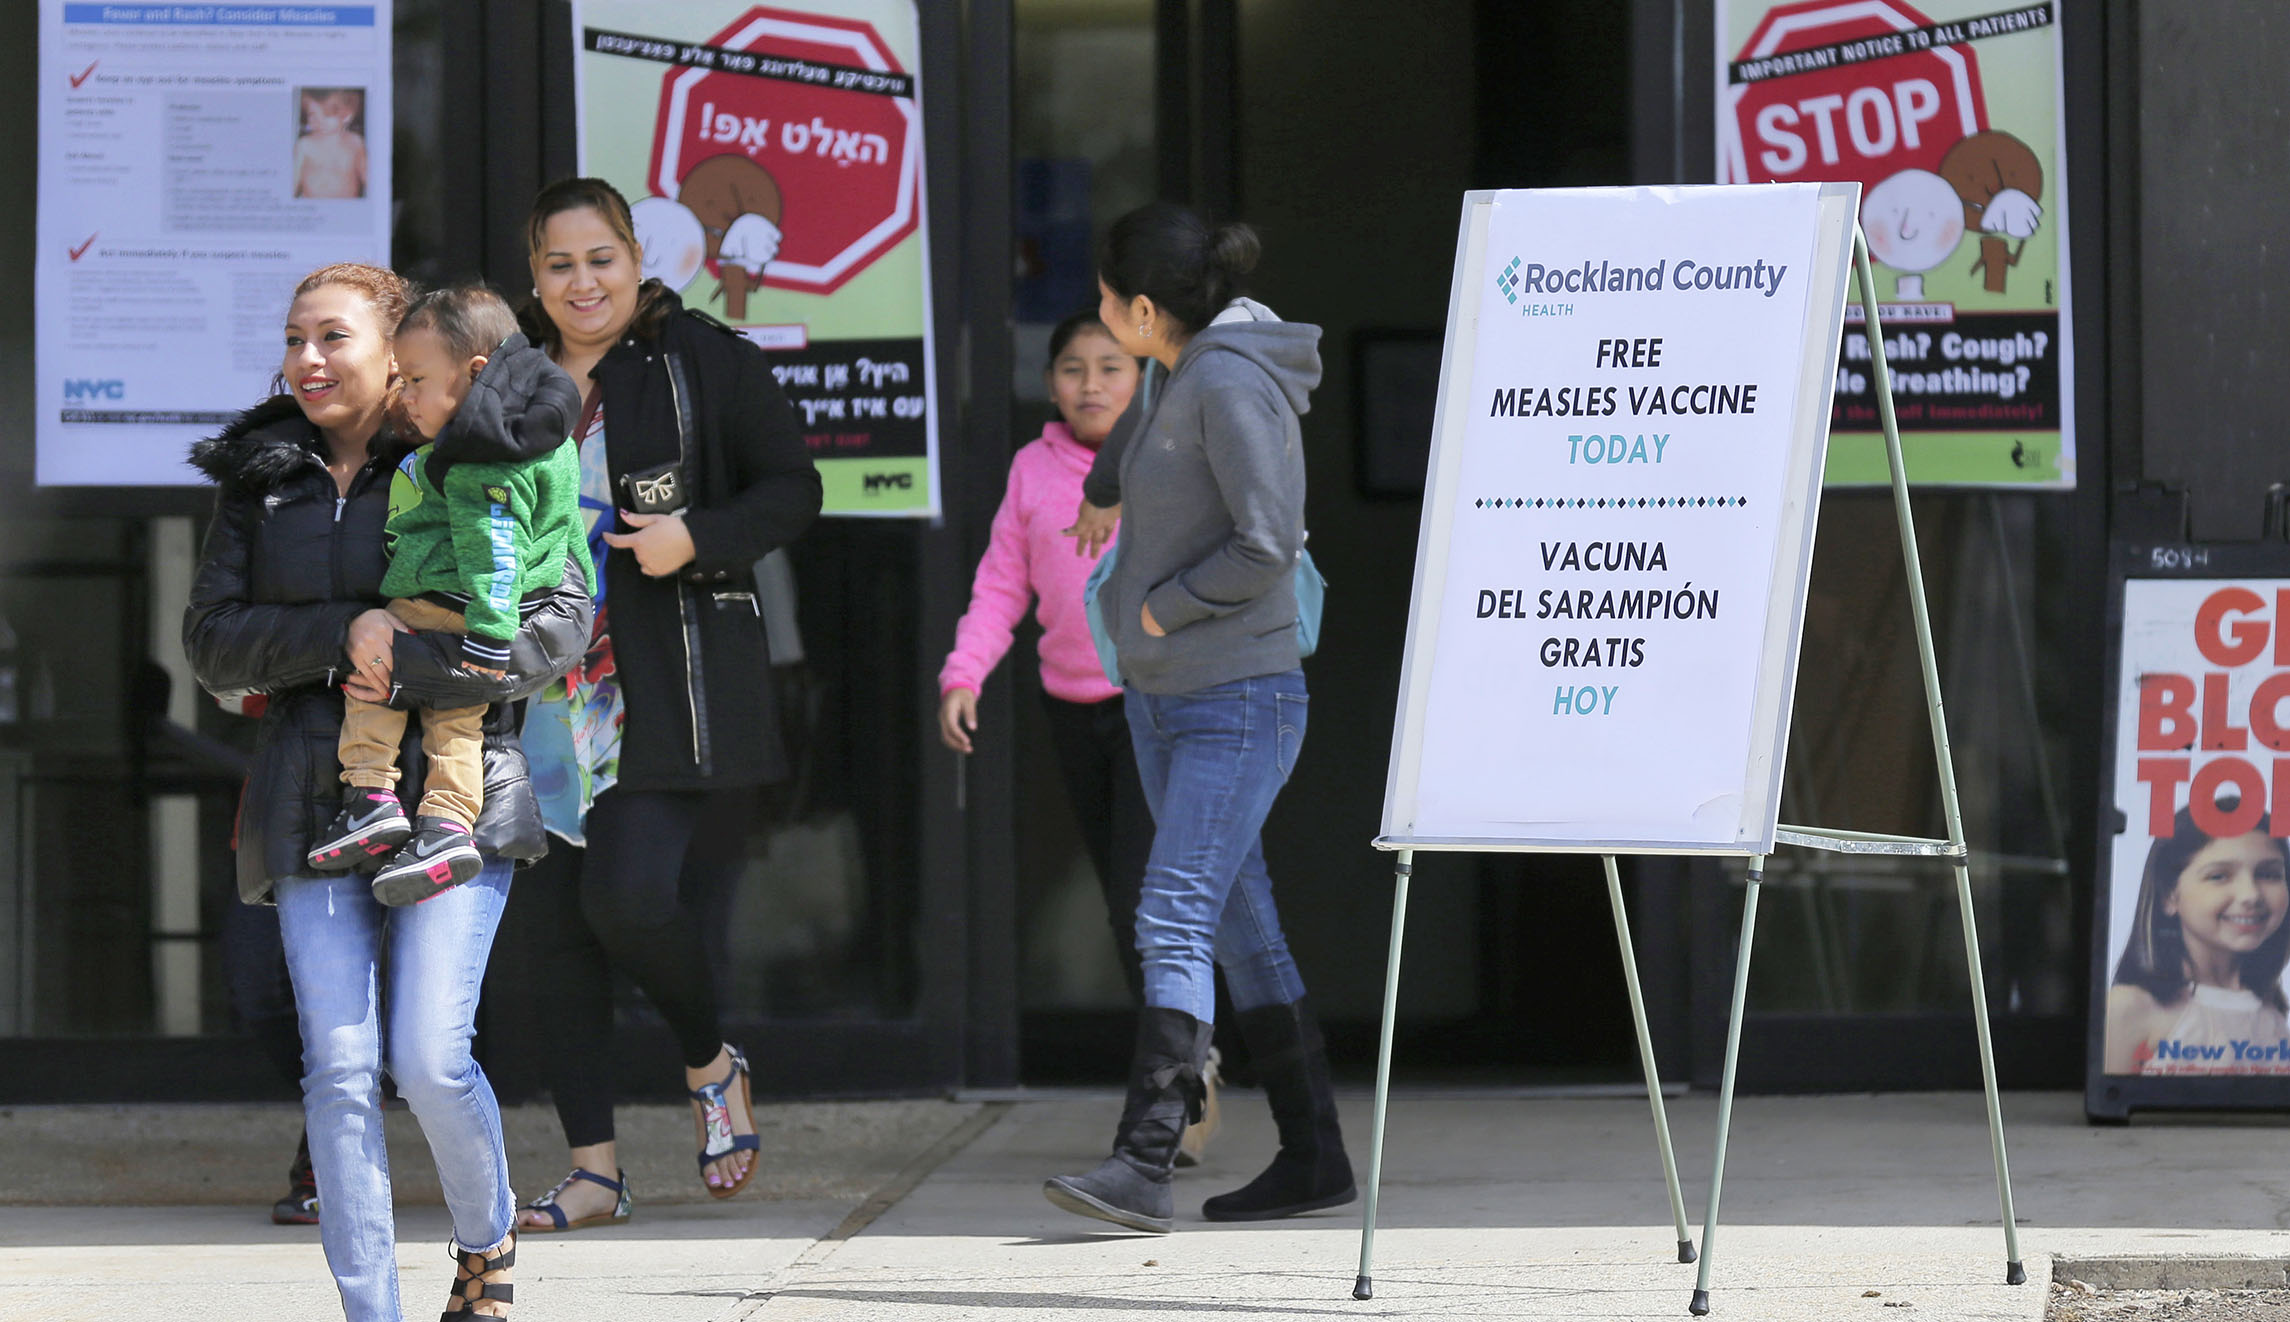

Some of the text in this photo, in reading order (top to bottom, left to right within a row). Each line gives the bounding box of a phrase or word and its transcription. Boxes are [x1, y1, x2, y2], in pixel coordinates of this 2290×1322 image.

[1739, 6, 2048, 81] IMPORTANT NOTICE TO ALL PATIENTS
[1755, 78, 1942, 175] STOP
[1525, 259, 1787, 297] Rockland County
[1522, 304, 1574, 316] HEALTH
[1596, 338, 1663, 368] FREE
[1846, 331, 2048, 365] Rsh? Cough?
[64, 378, 125, 400] NYC
[1490, 384, 1757, 417] MEASLES VACCINE
[1568, 434, 1670, 464] TODAY
[863, 473, 912, 490] NYC
[1540, 542, 1667, 571] VACUNA
[1476, 581, 1719, 619] DEL SARAMPIÓN
[1540, 638, 1645, 667] GRATIS
[1553, 686, 1619, 715] HOY
[2158, 1039, 2226, 1061] New
